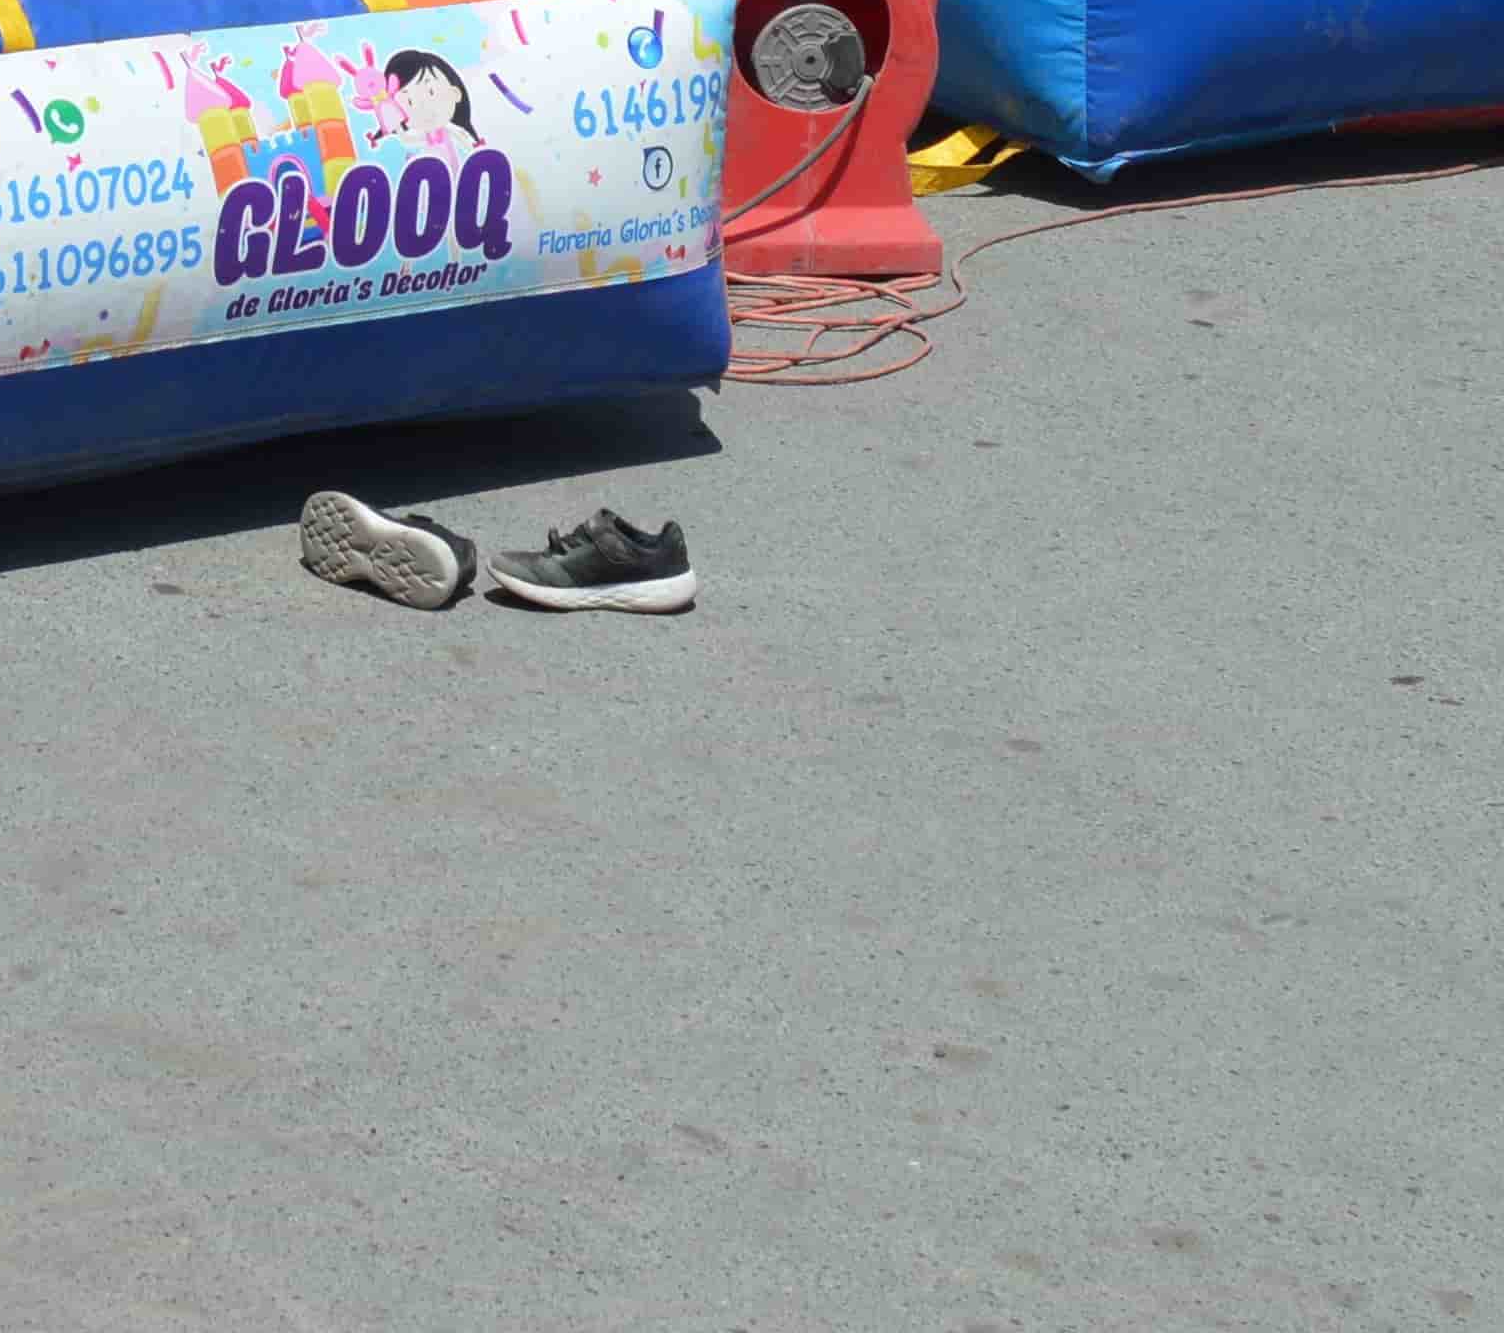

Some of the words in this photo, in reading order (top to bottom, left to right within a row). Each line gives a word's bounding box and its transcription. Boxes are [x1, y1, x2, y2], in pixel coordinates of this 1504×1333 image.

[574, 71, 721, 138] 6146199
[214, 149, 513, 285] GLOOQ
[538, 222, 612, 255] Floreria
[226, 292, 258, 320] de
[268, 277, 373, 314] Gloria's
[380, 261, 488, 296] Decoflor
